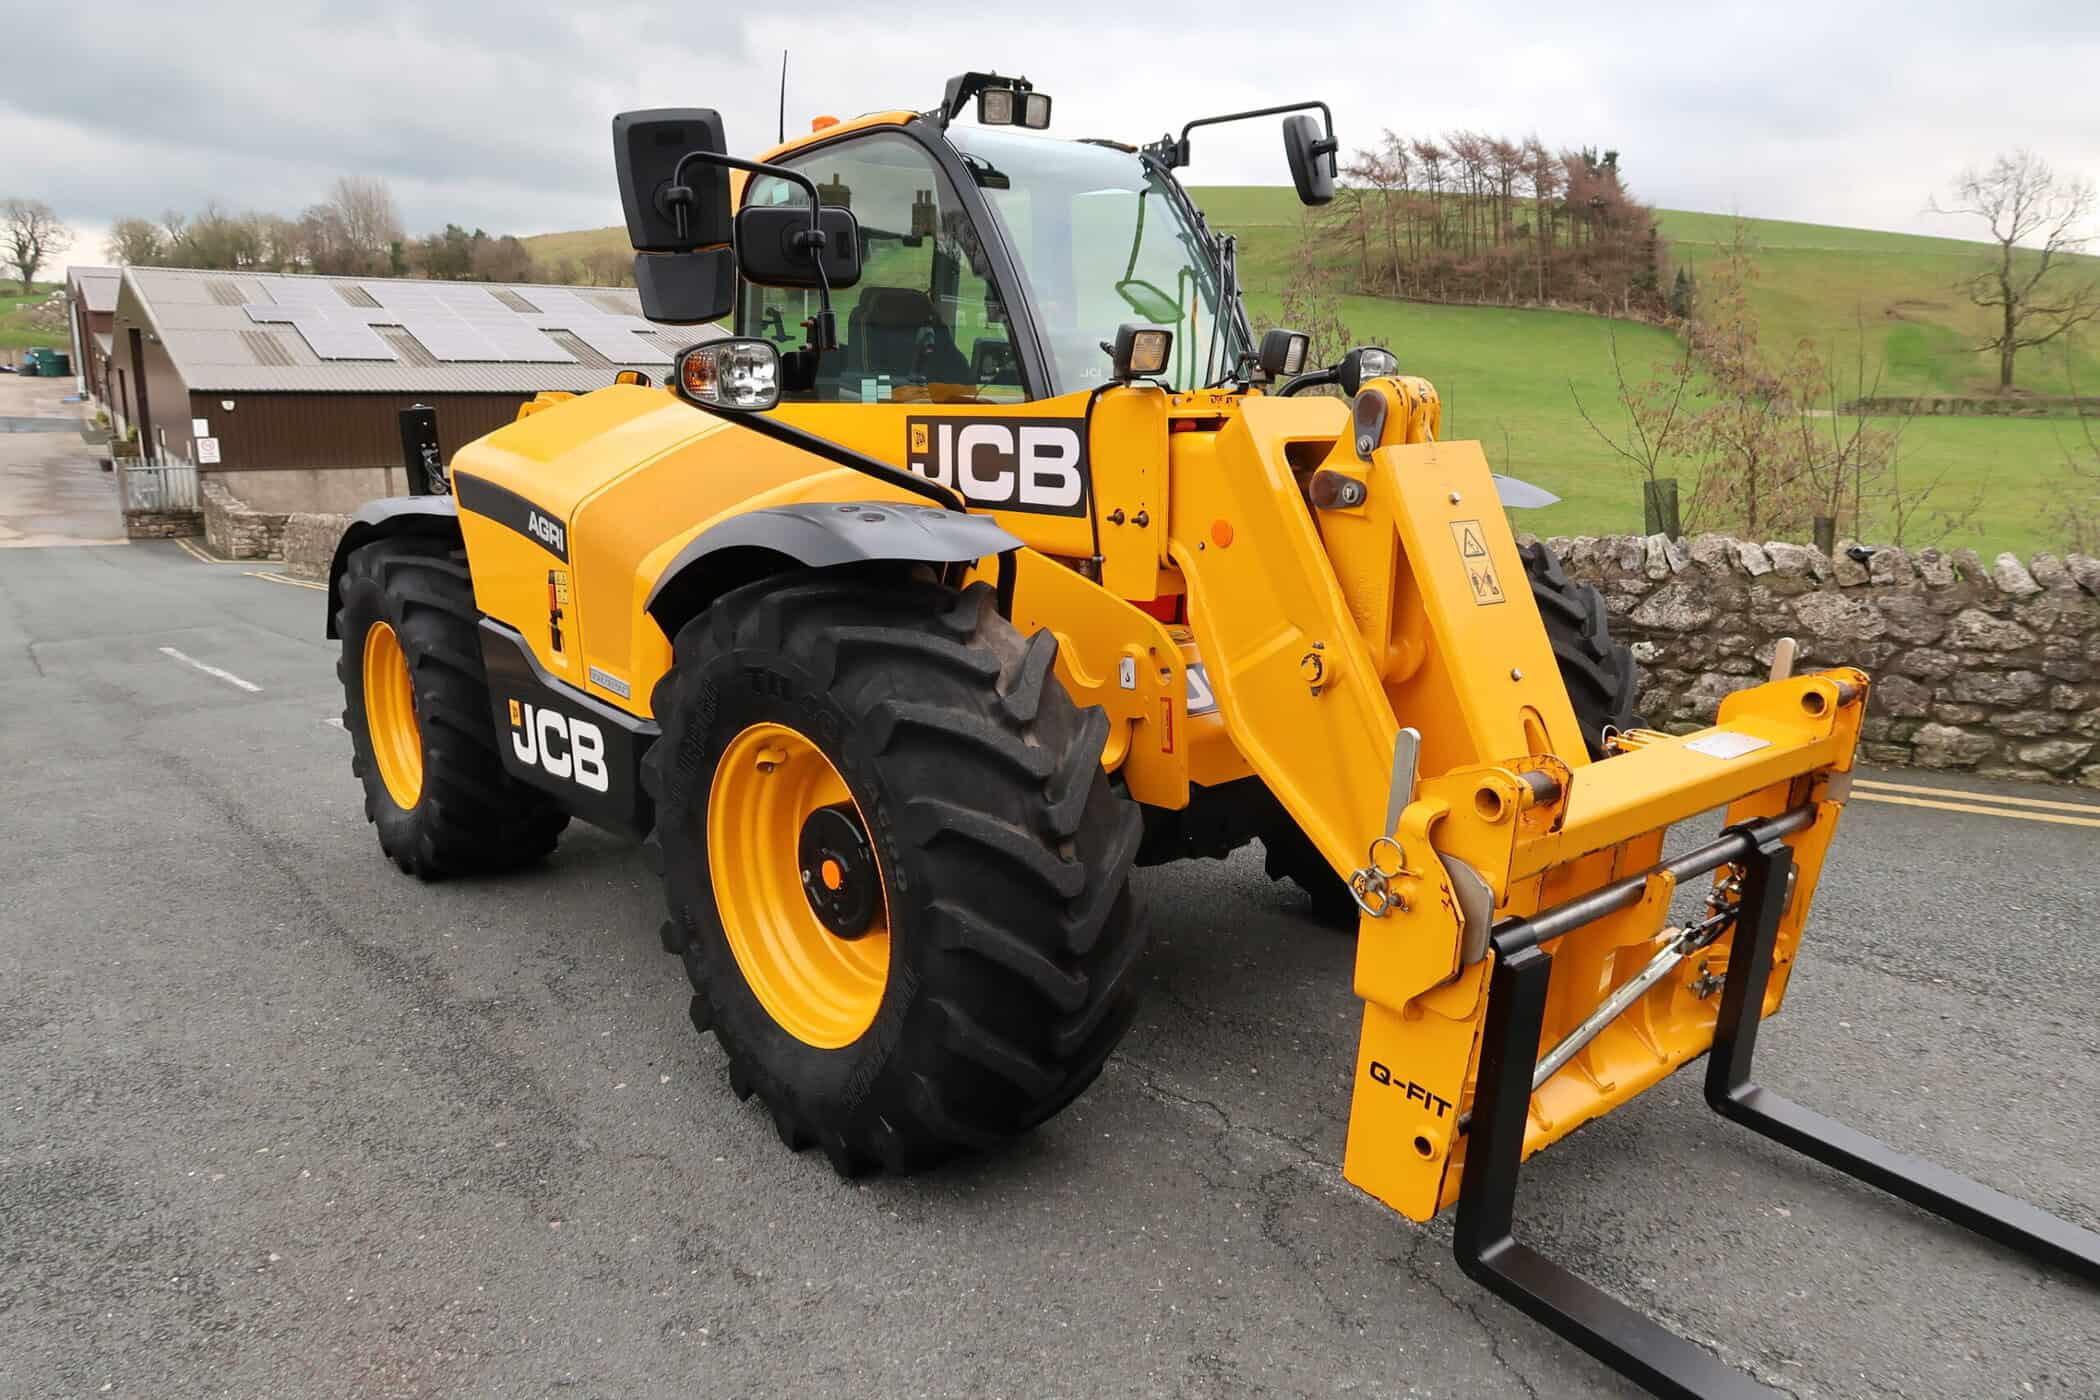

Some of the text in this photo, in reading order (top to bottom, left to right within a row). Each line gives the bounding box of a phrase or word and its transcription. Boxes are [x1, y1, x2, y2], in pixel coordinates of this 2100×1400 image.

[912, 423, 1082, 507] JCB
[528, 511, 564, 552] AGRI
[509, 699, 609, 793] JCB
[1369, 1061, 1452, 1118] Q-FIT
